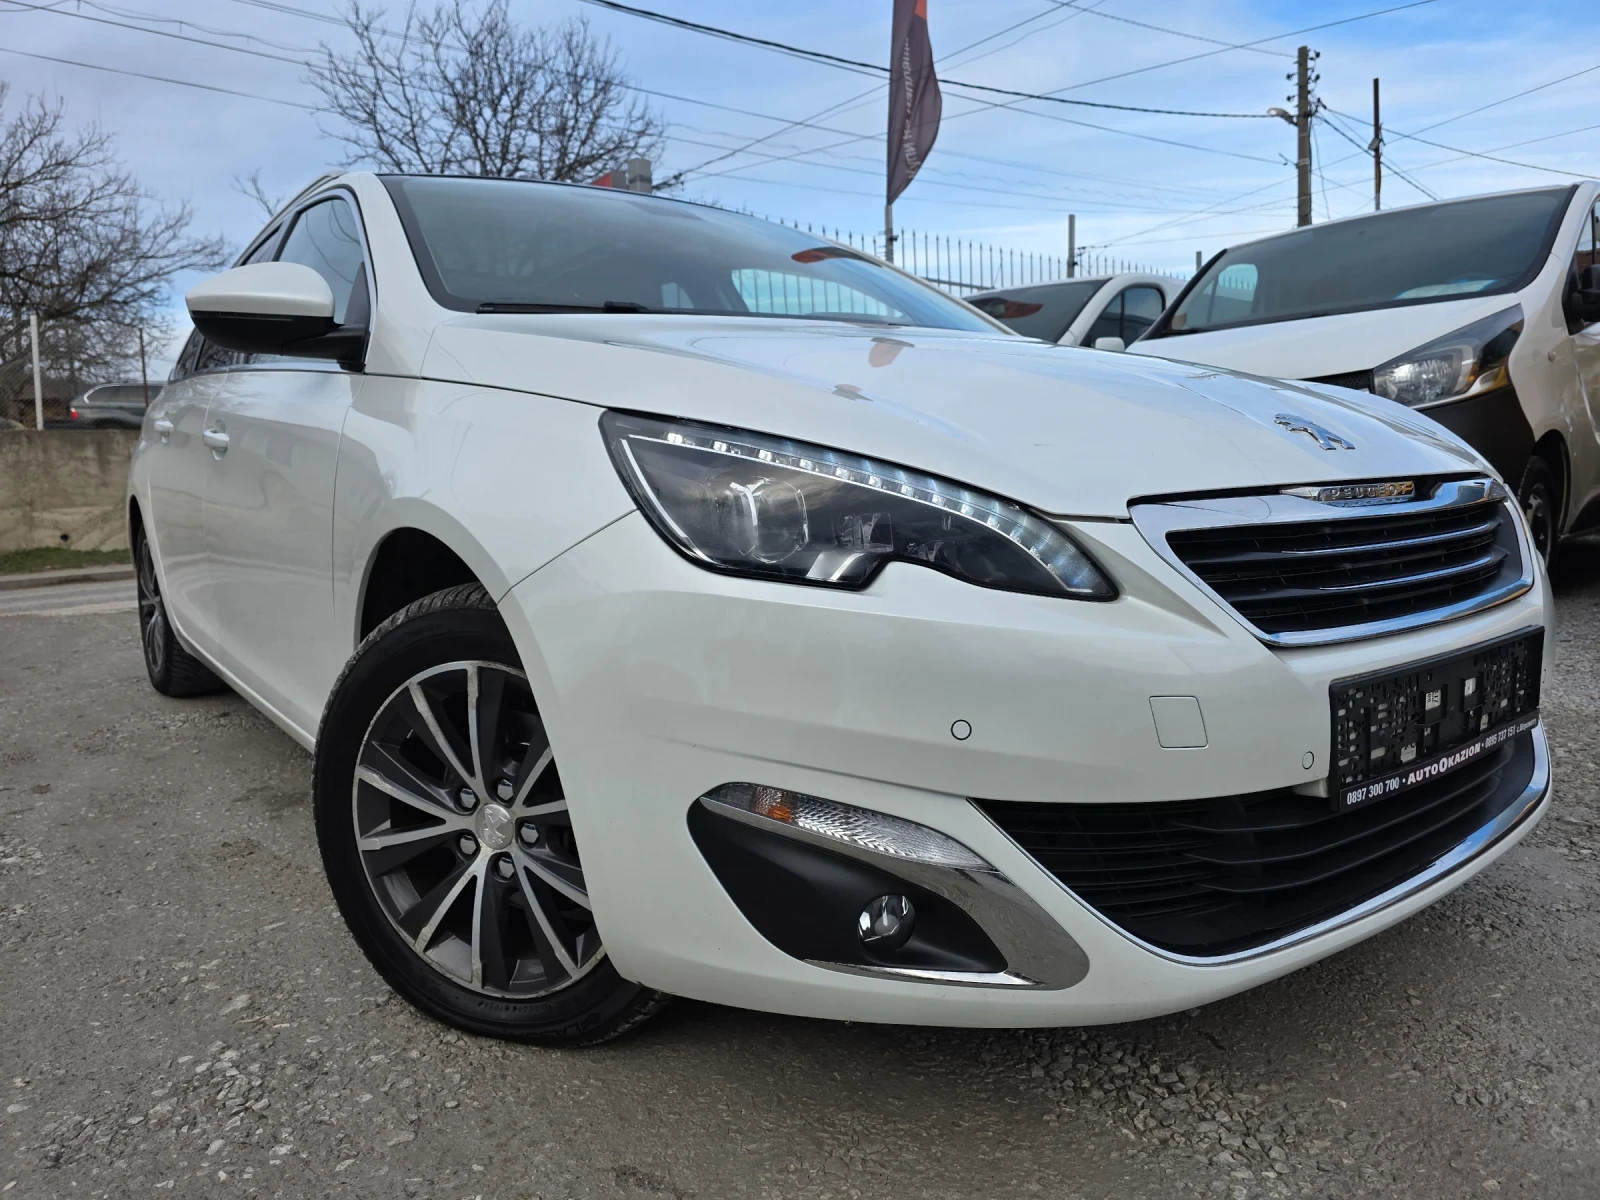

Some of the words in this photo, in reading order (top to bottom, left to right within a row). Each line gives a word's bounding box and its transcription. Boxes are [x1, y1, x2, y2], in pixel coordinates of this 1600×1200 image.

[1331, 483, 1406, 500] PEUGEOT
[1346, 787, 1367, 805] 0897
[1368, 781, 1384, 798] 300
[1385, 776, 1399, 793] 700
